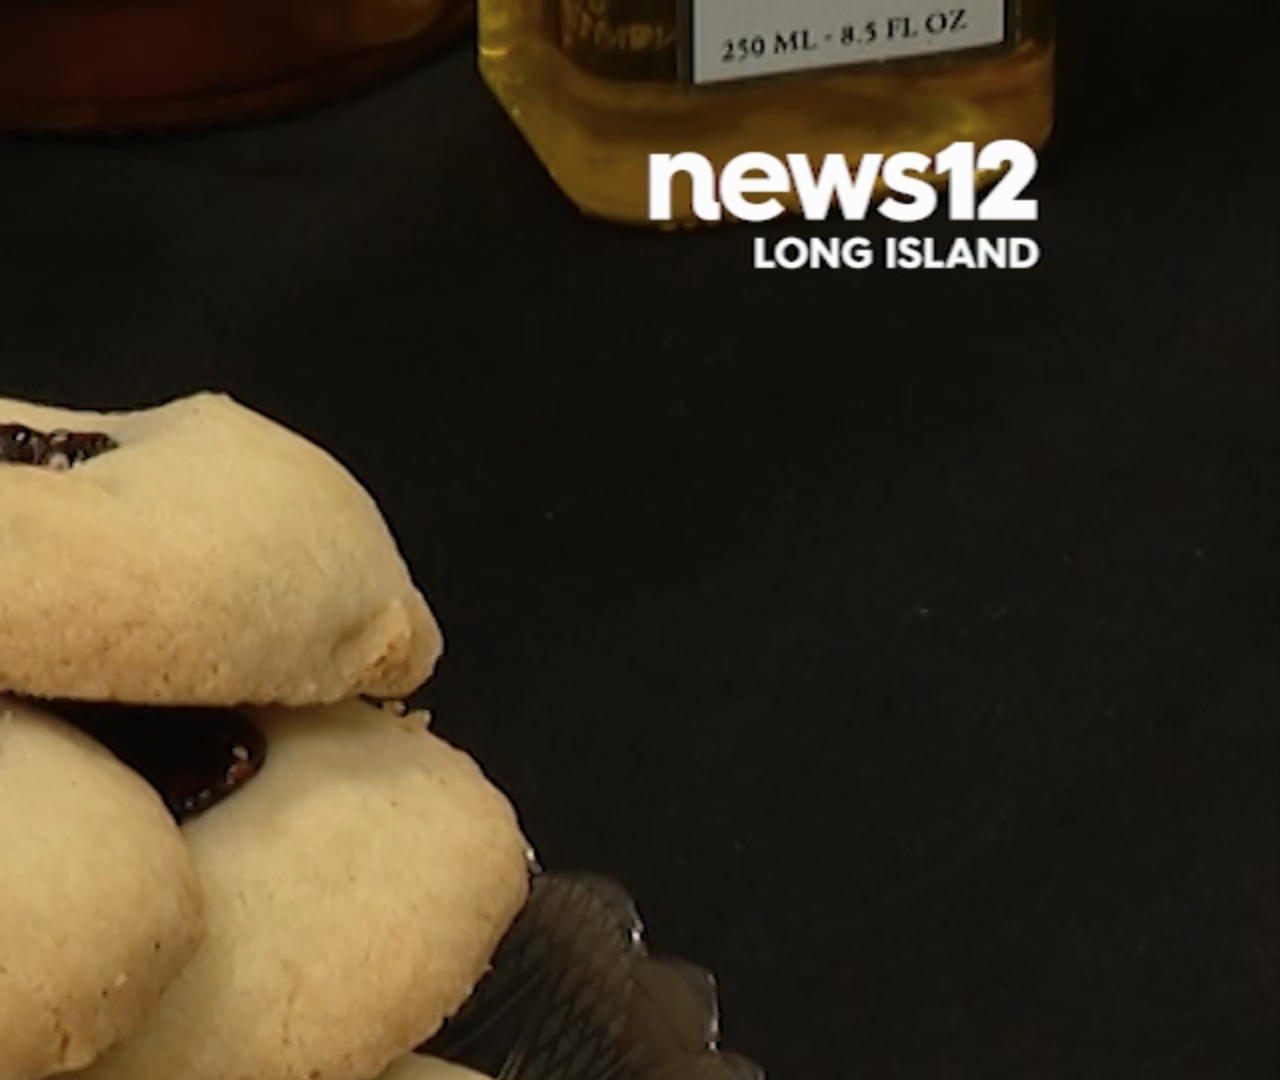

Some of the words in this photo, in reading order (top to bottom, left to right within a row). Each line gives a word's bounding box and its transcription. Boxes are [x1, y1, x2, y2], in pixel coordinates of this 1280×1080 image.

[720, 37, 766, 63] 250
[773, 29, 817, 56] ML
[840, 22, 877, 47] 8.5
[886, 16, 918, 40] FL
[925, 8, 967, 35] OZ
